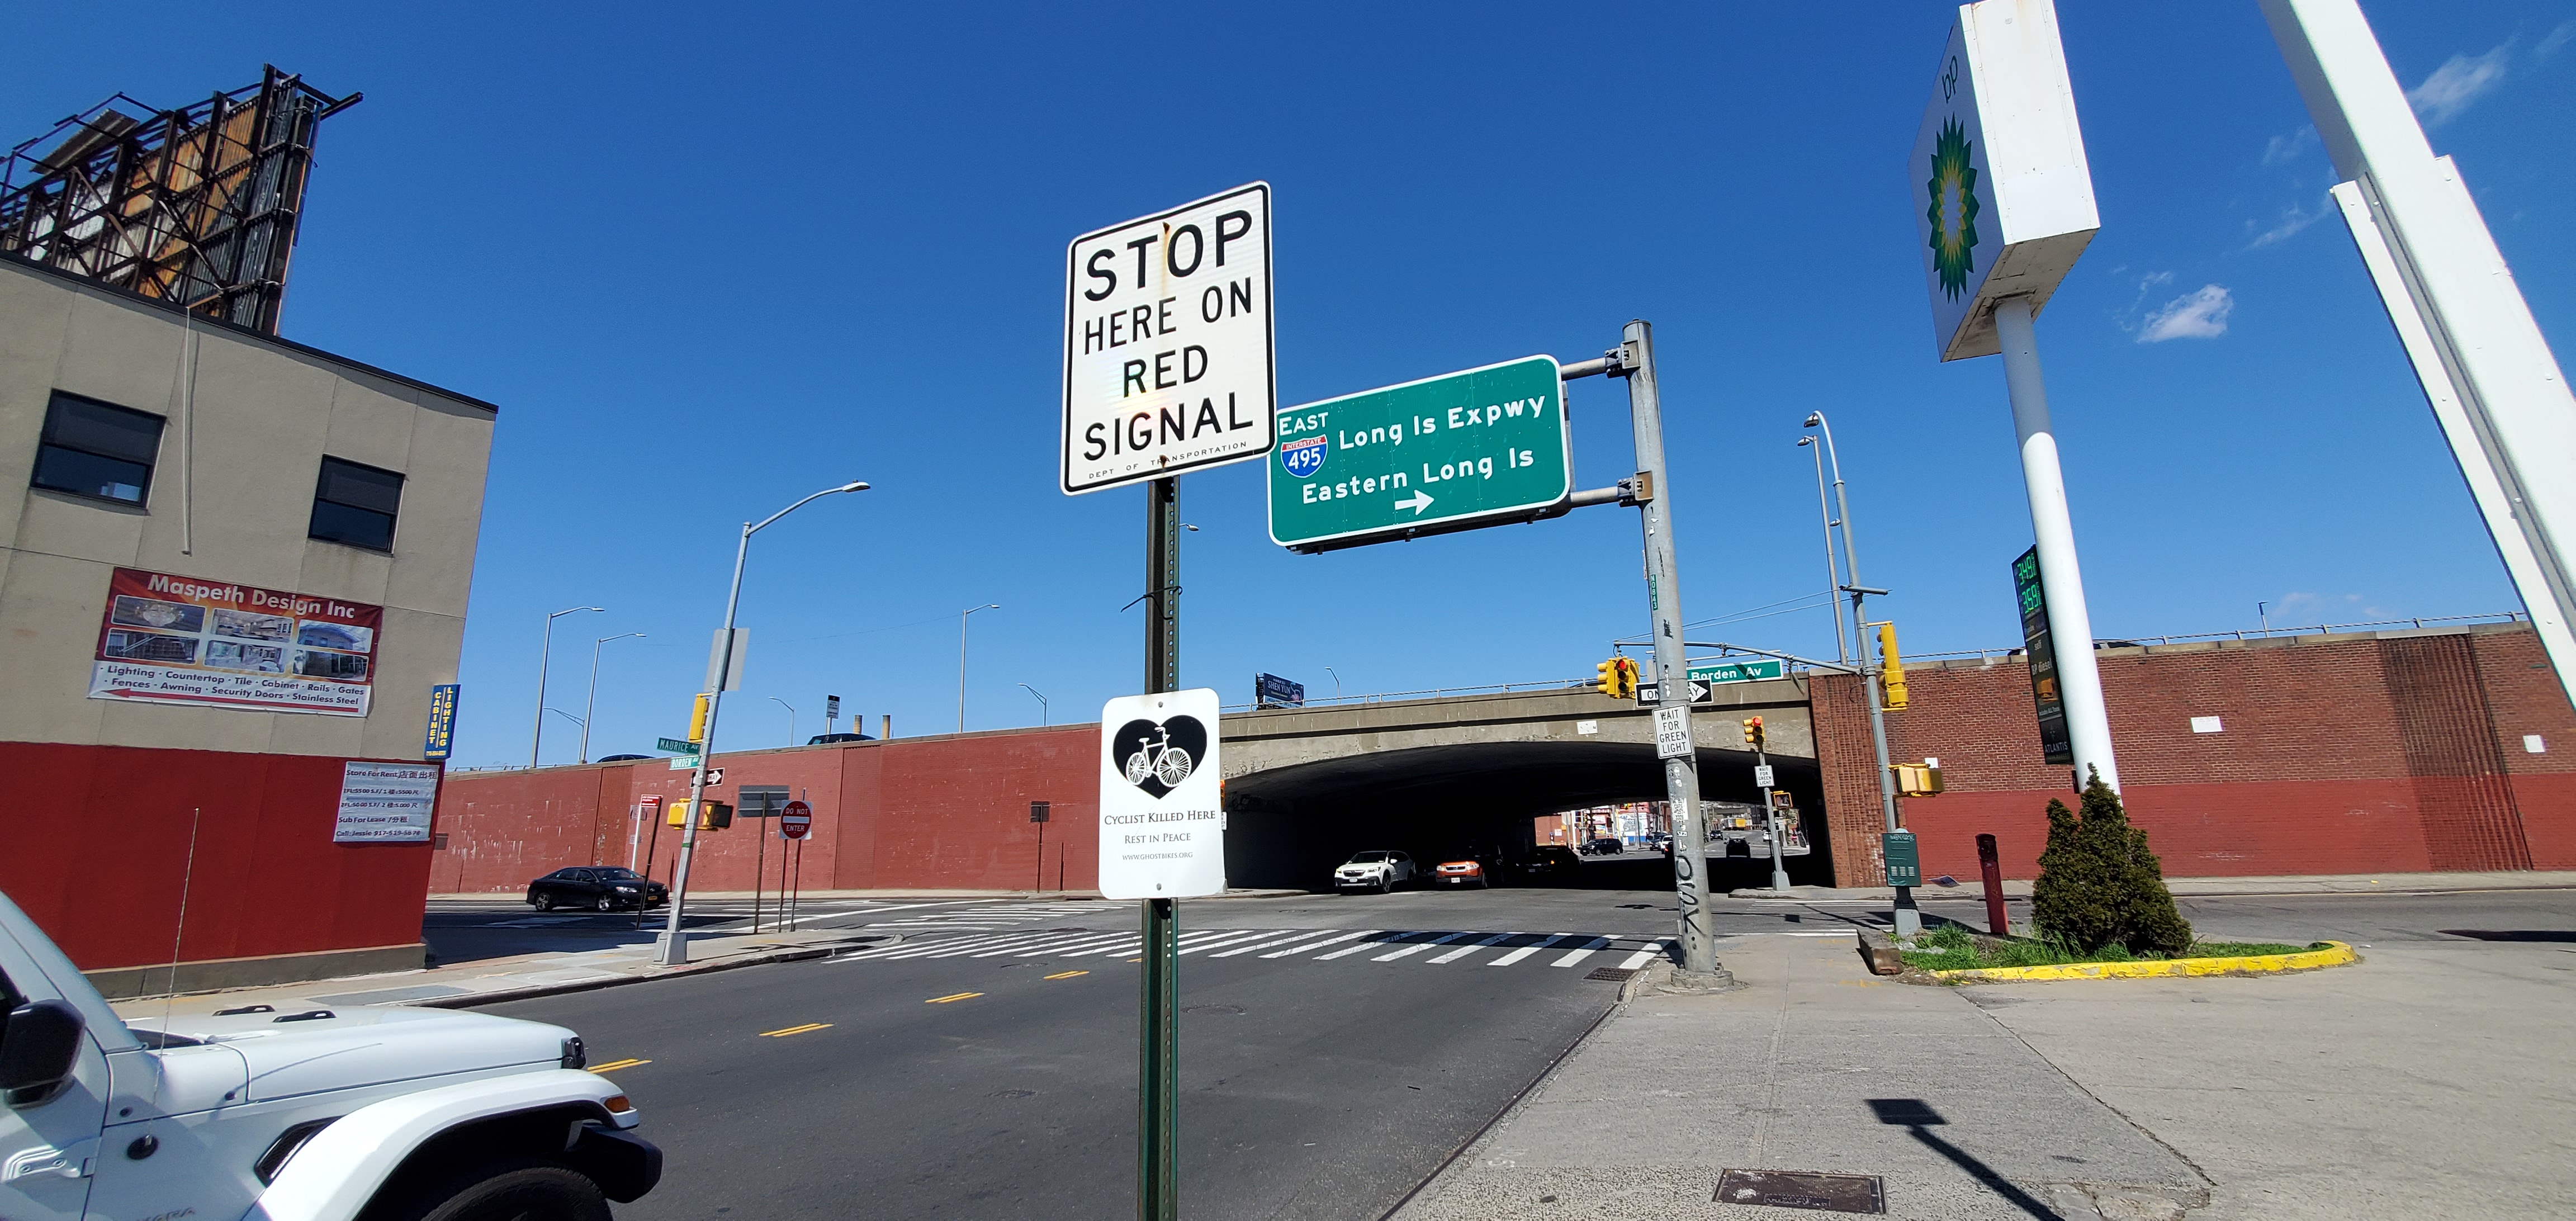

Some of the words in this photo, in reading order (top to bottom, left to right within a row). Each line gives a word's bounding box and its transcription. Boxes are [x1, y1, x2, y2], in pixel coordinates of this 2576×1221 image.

[1943, 55, 1958, 103] bp
[1084, 210, 1252, 301] STOP
[1085, 296, 1177, 355] HERE
[1202, 277, 1252, 323] ON
[1124, 344, 1208, 398] RED
[1083, 392, 1253, 461] SIGNAL
[1279, 412, 1328, 436] EAST
[1340, 423, 1402, 449] Long
[1414, 415, 1436, 436] Is
[1448, 395, 1545, 429] Expwy
[1286, 438, 1322, 449] INTERSTATE
[1089, 469, 1114, 479] DEPT
[1150, 441, 1247, 466] TRANSPORTATION
[1289, 447, 1320, 470] 495
[1303, 471, 1407, 504] Eastern
[1423, 456, 1493, 483] Long
[1509, 447, 1534, 468] Is
[148, 575, 245, 603] Maspeth
[252, 590, 321, 614] Design
[327, 603, 354, 618] Inc
[107, 665, 155, 679] Lighting
[165, 670, 224, 685] Countertop
[235, 676, 252, 686] Tile
[262, 679, 299, 690] Cabinet
[307, 684, 330, 693] Rails
[338, 687, 364, 695] Gates
[1267, 680, 1280, 692] SHEN
[1281, 684, 1291, 694] YUN
[1691, 669, 1737, 680] Borden
[1745, 666, 1761, 676] Av
[112, 678, 150, 689] Fences
[160, 682, 201, 694] Awning
[211, 687, 252, 698] Security
[255, 690, 283, 699] Doors
[292, 693, 333, 703] Stainless
[336, 696, 358, 706] Steel
[428, 692, 442, 744] CABINET
[439, 687, 453, 746] LIGHTING
[1660, 709, 1678, 721] WAIT
[1663, 721, 1679, 731] FOR
[660, 739, 689, 752] MAURICE
[1659, 730, 1687, 742] GREEN
[1662, 742, 1685, 753] LIGHT
[2045, 741, 2068, 753] ATLANTIS
[671, 758, 692, 768] BORDEN
